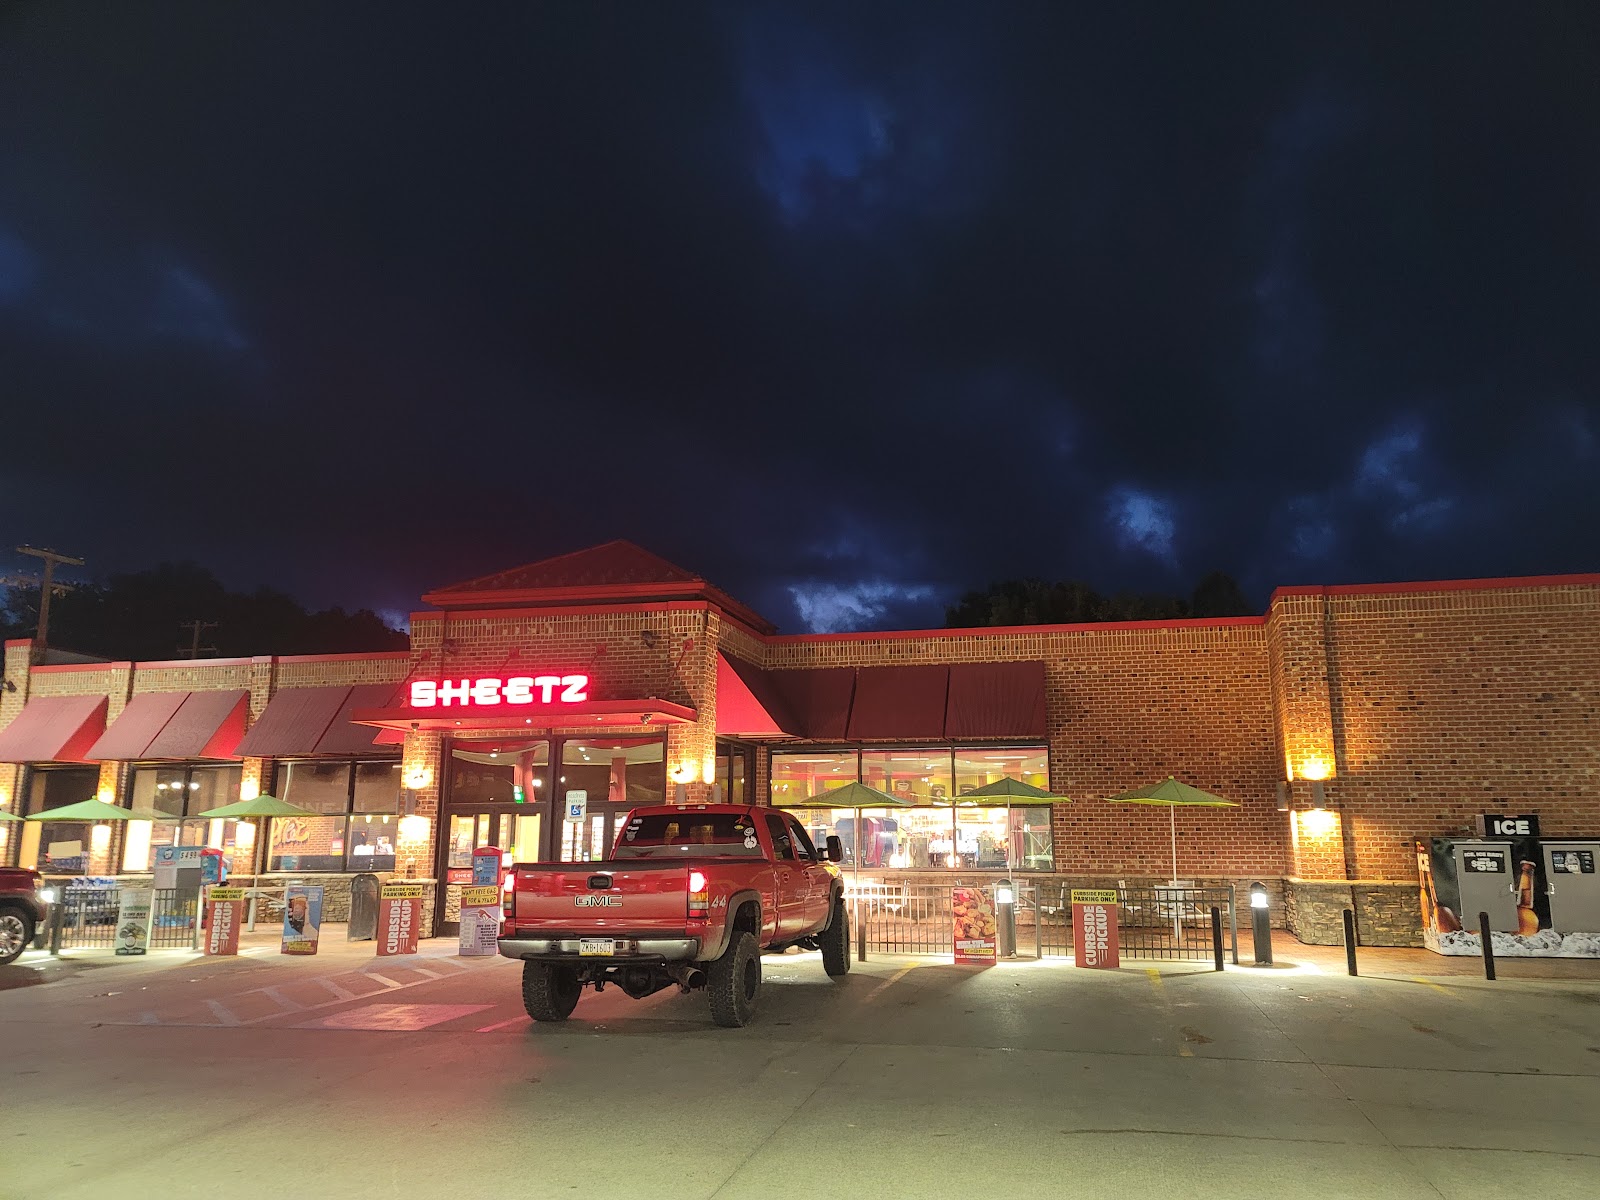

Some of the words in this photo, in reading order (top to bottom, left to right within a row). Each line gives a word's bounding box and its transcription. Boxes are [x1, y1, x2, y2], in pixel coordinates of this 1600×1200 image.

[410, 674, 588, 708] SHEETZ
[1493, 820, 1530, 835] ICE
[1417, 852, 1430, 872] ICE
[220, 901, 233, 940] PICKUP
[400, 900, 412, 939] PICKUP
[575, 895, 623, 907] GMC
[210, 902, 223, 954] CURBSIDE
[387, 899, 401, 954] CURBSIDE
[1084, 906, 1097, 966] CURBSIDE
[1096, 906, 1108, 949] PICKUP
